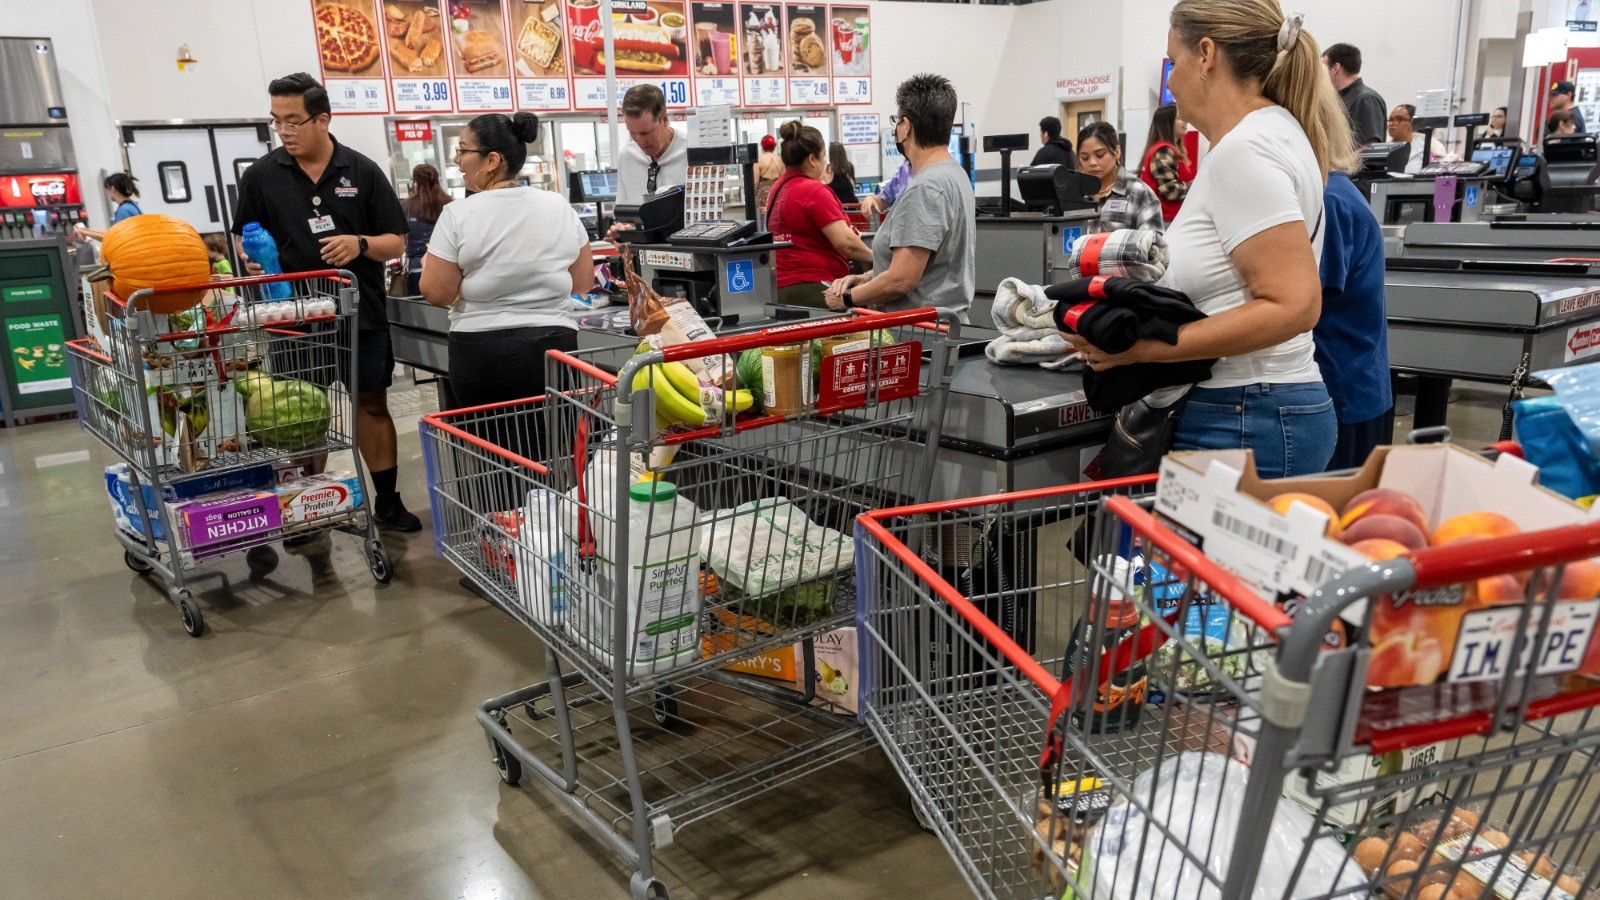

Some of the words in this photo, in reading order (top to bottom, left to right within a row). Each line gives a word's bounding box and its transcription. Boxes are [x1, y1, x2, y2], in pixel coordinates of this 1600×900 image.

[855, 81, 867, 95] .79
[1056, 75, 1111, 88] MERCHANDISE
[423, 82, 448, 101] 3.99
[493, 87, 509, 99] 6.99
[550, 87, 565, 99] 6.99
[661, 81, 686, 103] 1.50
[1068, 86, 1098, 95] PICK-UP
[32, 320, 59, 328] WASTE
[767, 324, 801, 333] COSTCO
[1061, 403, 1091, 426] LEAVE
[301, 489, 335, 504] Premier
[304, 500, 333, 513] Protein
[205, 512, 222, 522] Bags
[227, 509, 252, 520] GALLON
[207, 515, 269, 539] KITCHEN
[1457, 640, 1502, 679] IM
[1410, 746, 1437, 770] UBER
